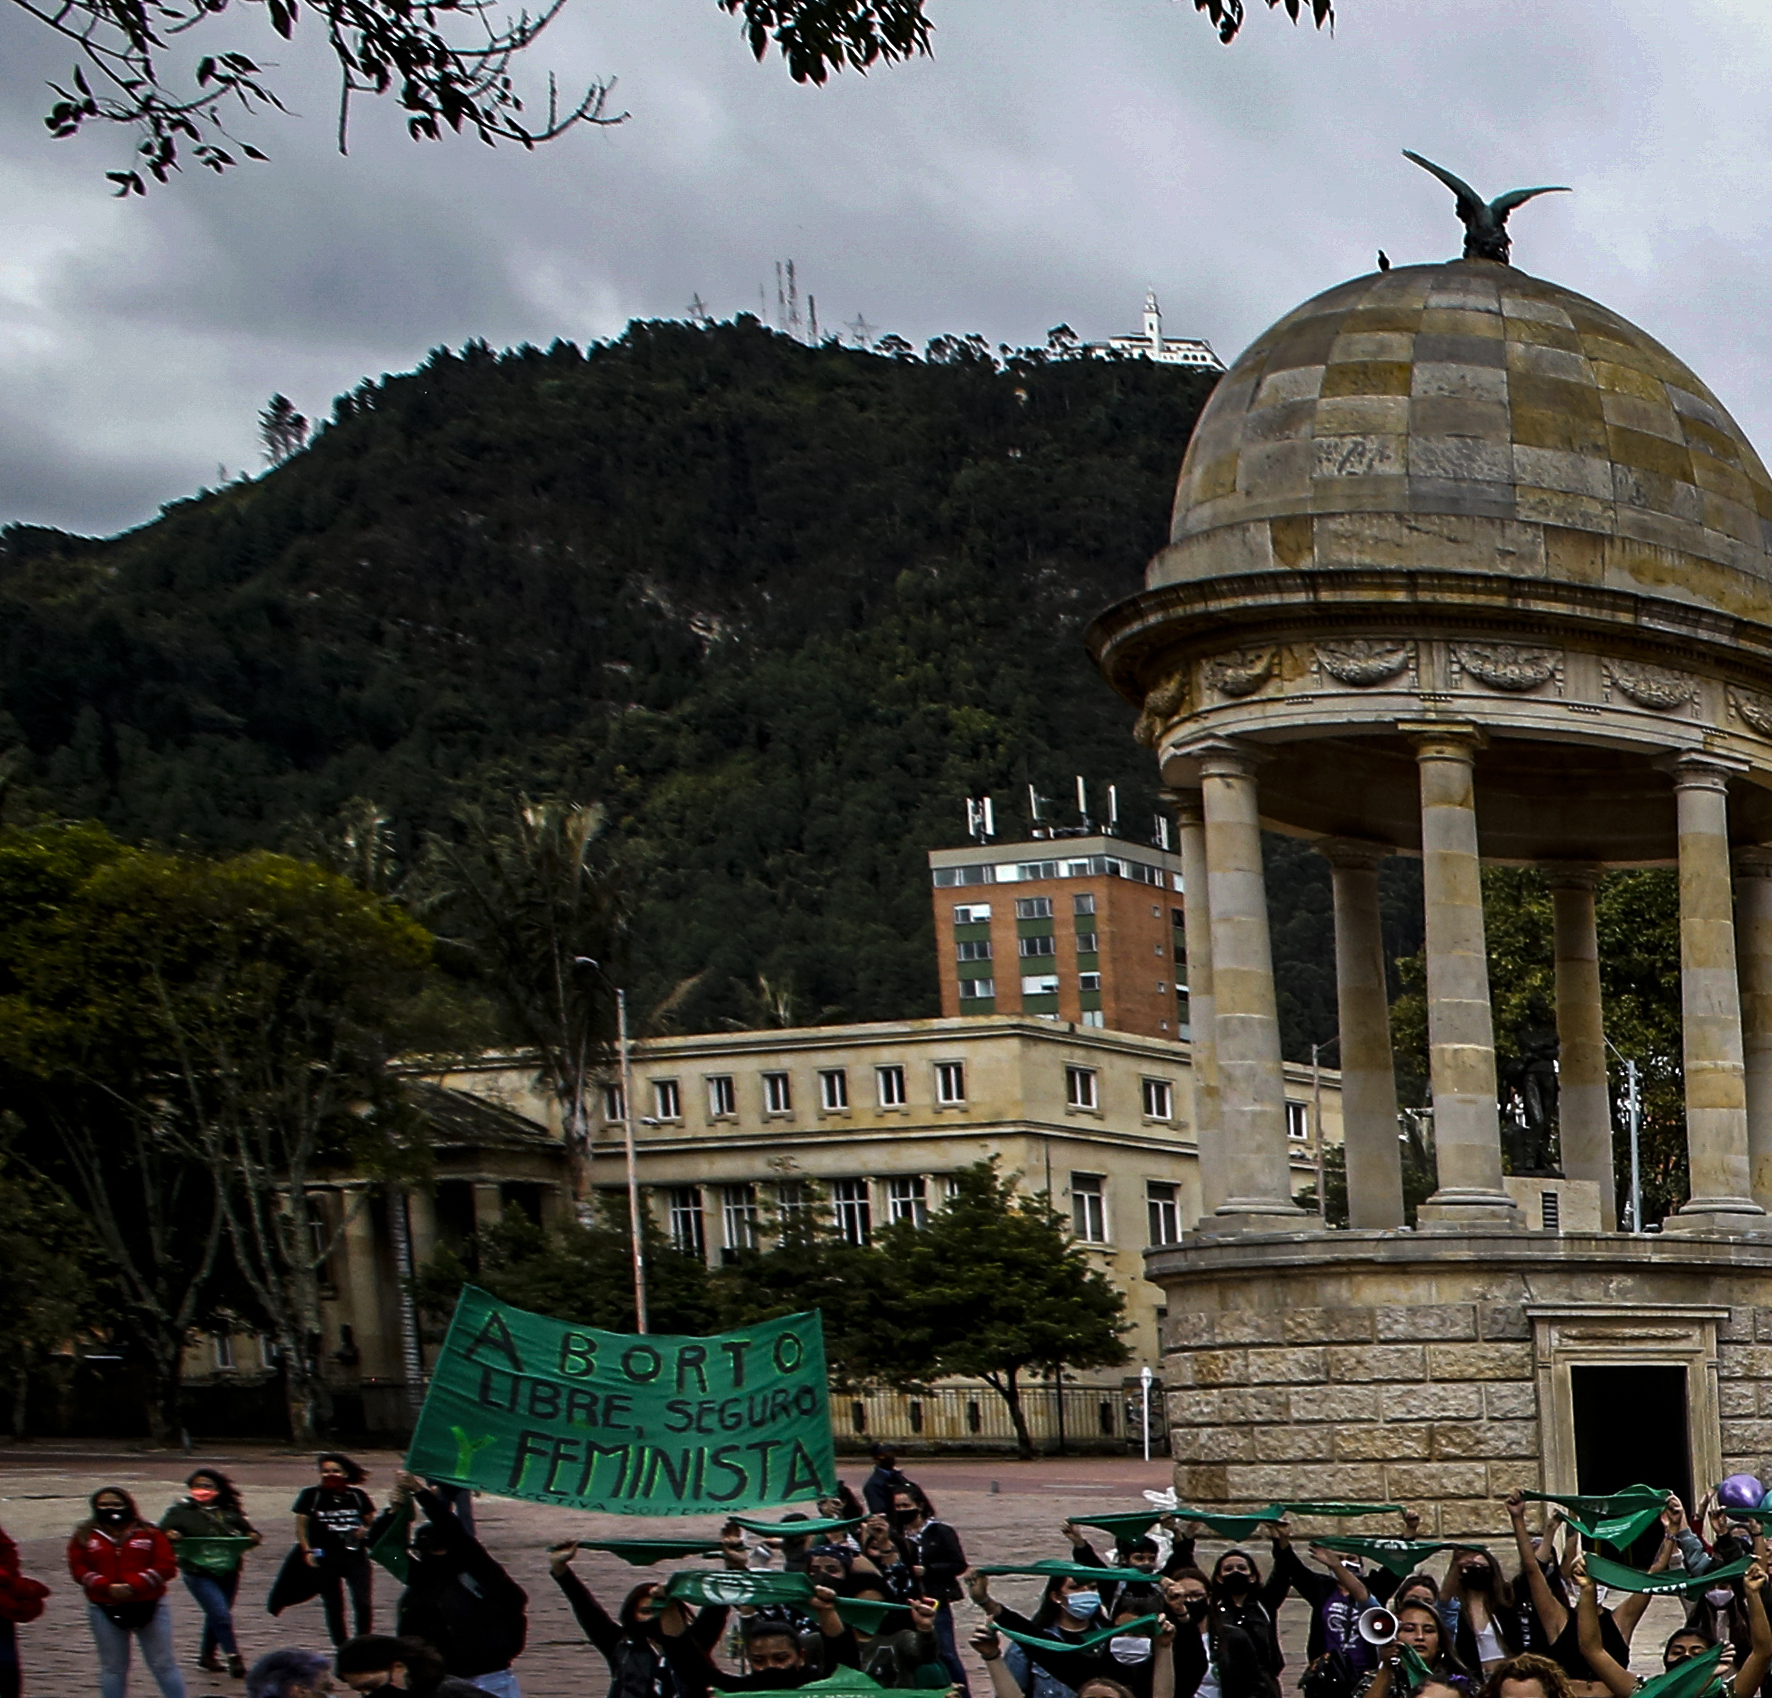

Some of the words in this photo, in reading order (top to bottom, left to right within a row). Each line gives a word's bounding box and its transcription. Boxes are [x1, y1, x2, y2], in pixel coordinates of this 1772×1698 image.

[465, 1309, 805, 1395] ABORTO
[477, 1370, 646, 1439] LIBRE,
[663, 1385, 819, 1434] SEGURO
[449, 1425, 498, 1479] Y
[507, 1430, 828, 1501] FEMINISTA
